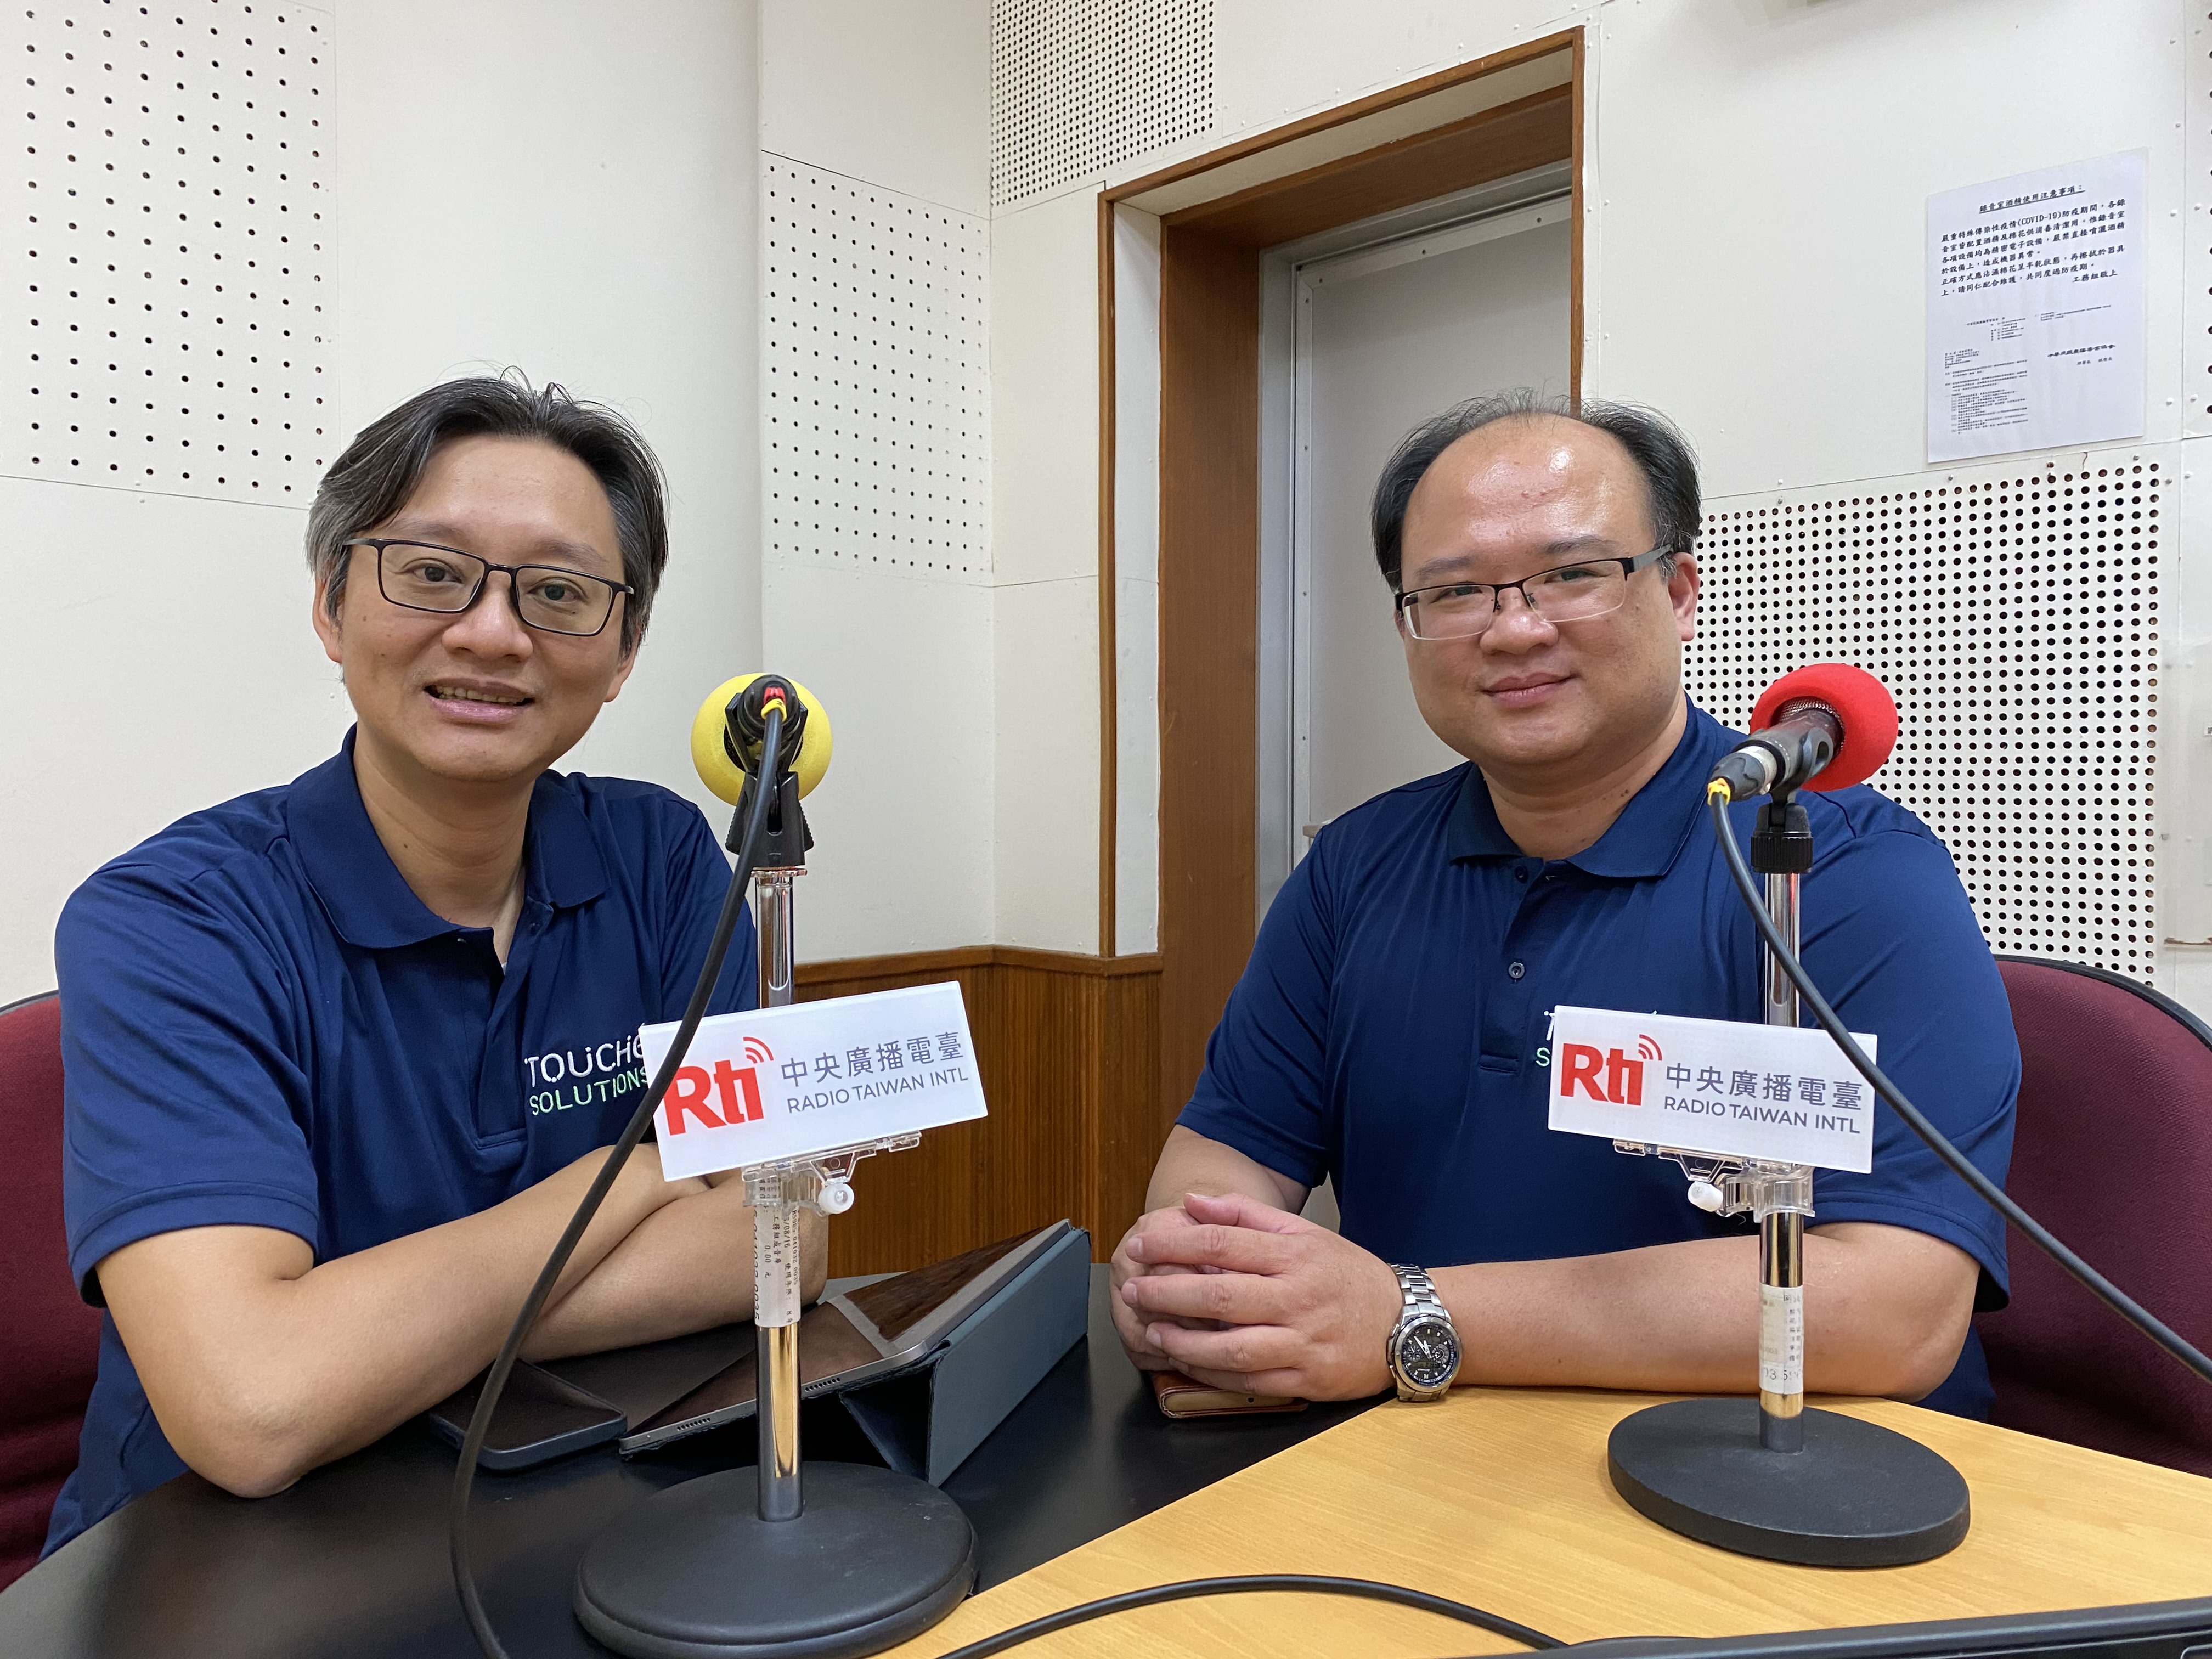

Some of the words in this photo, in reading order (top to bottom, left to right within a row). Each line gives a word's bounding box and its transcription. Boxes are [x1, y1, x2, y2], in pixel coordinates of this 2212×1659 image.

[781, 1031, 963, 1087] 中央廣播電臺
[787, 1088, 850, 1113] RADIO
[852, 1074, 924, 1101] TAIWAN
[930, 1068, 968, 1086] INTL
[1666, 1063, 1863, 1110] 中央廣播電臺
[1664, 1096, 1725, 1116] RADIO
[1729, 1103, 1807, 1127] TAIWAN
[1815, 1114, 1860, 1134] INTL
